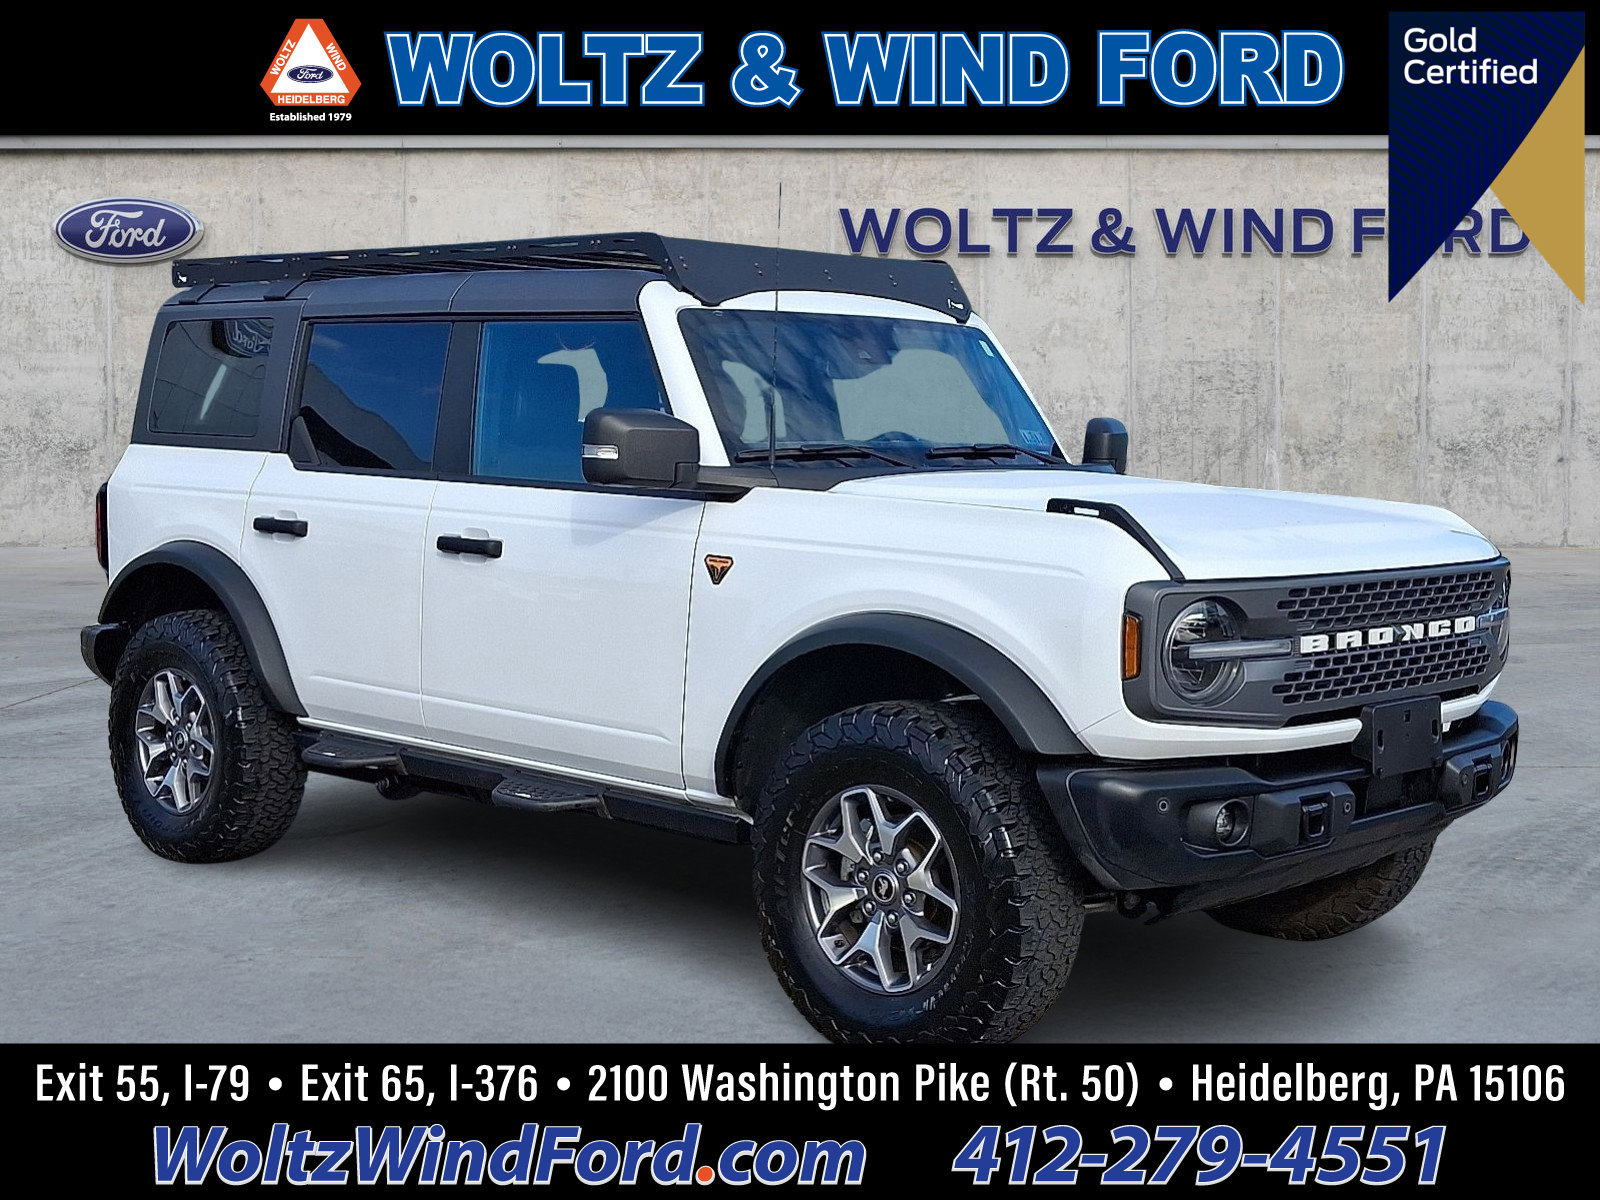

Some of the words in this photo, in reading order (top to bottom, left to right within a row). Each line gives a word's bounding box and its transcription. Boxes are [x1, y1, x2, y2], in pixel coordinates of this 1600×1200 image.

[85, 209, 167, 248] Ford
[840, 208, 1074, 255] WOLTZ
[1091, 207, 1136, 255] &
[1155, 208, 1334, 255] WIND
[1352, 207, 1531, 256] FRD
[1300, 616, 1476, 654] BRONCO
